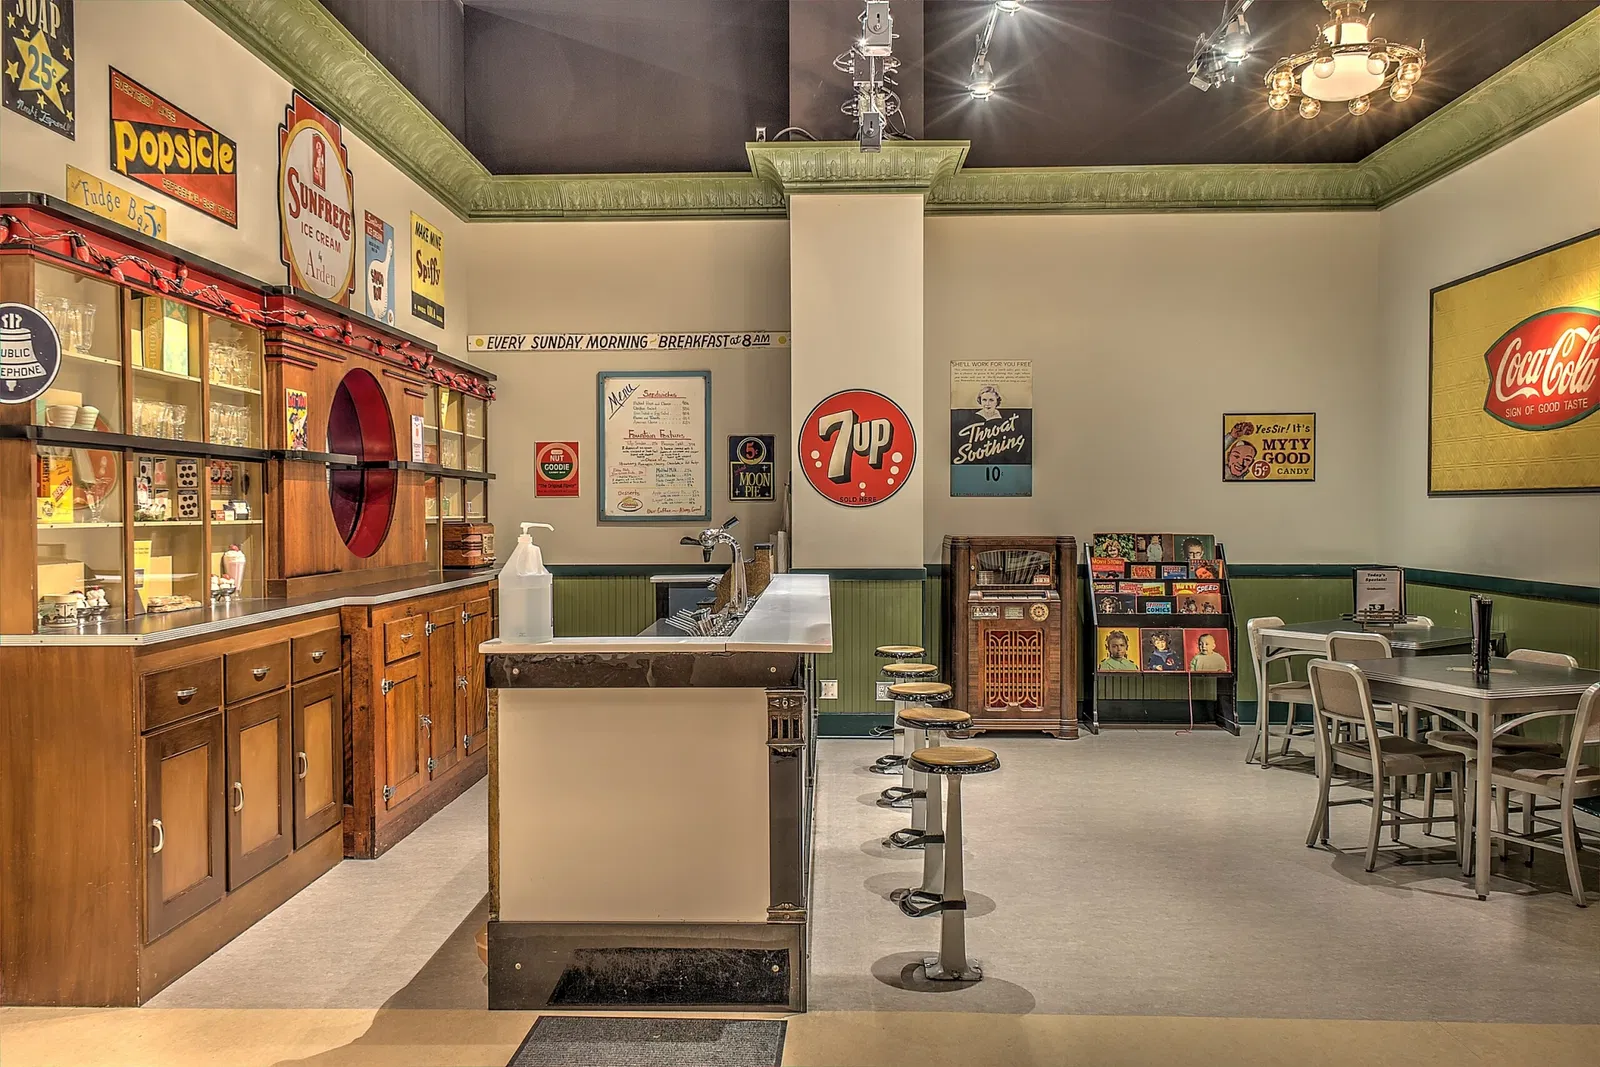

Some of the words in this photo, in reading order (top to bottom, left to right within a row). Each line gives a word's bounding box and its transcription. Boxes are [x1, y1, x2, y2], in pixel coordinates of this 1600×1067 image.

[82, 181, 120, 212] Fudge
[288, 166, 351, 241] SUNFREZE
[301, 221, 313, 239] ICE
[316, 230, 341, 253] CREAM
[415, 221, 428, 243] MAKE
[430, 231, 442, 251] MINE
[305, 249, 336, 287] Arden
[416, 249, 441, 286] Spiffy
[0, 348, 30, 358] UBLIC
[487, 337, 526, 350] EVERY
[531, 336, 583, 350] SUNDAY
[586, 335, 648, 349] MORNING
[658, 335, 730, 348] BREAKFAST
[730, 335, 741, 345] at
[742, 334, 752, 347] 8
[753, 334, 770, 346] AM
[608, 383, 638, 414] Menu
[1505, 407, 1522, 418] SIGN
[1525, 405, 1535, 416] OF
[1538, 401, 1560, 414] GOOD
[1564, 398, 1588, 411] TASTE
[958, 413, 1019, 444] Throat
[1292, 423, 1310, 433] It's
[953, 434, 1025, 465] Soothing
[1262, 438, 1311, 450] MYTY
[544, 463, 570, 471] GOODIE
[1262, 452, 1311, 464] GOOD
[739, 472, 771, 487] MOON
[744, 486, 761, 497] PIE
